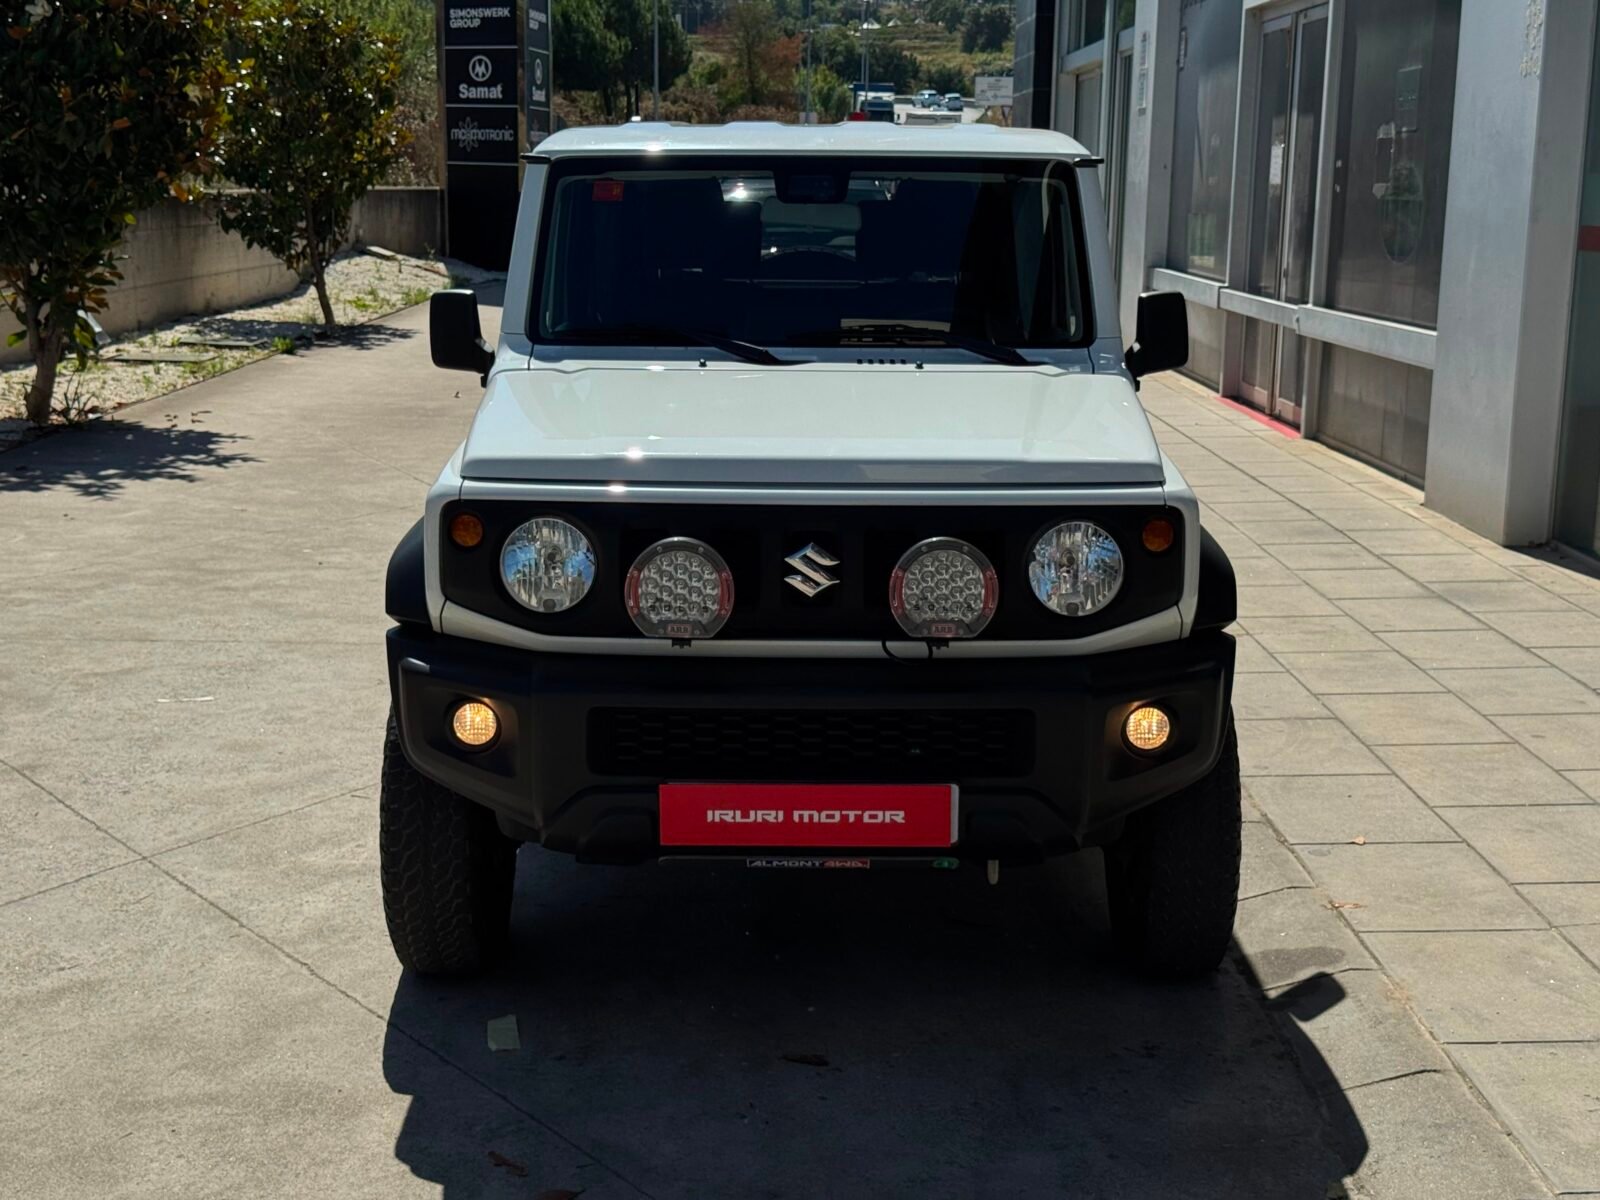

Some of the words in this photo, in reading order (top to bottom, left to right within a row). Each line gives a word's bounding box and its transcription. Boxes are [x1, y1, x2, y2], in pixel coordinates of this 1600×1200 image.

[450, 7, 511, 18] SIMONSWERK
[450, 18, 481, 28] GROUP
[459, 83, 503, 99] Samat
[669, 625, 689, 633] ARB
[934, 625, 953, 633] ARB
[707, 810, 784, 823] IRURI
[793, 810, 905, 823] MOTOR
